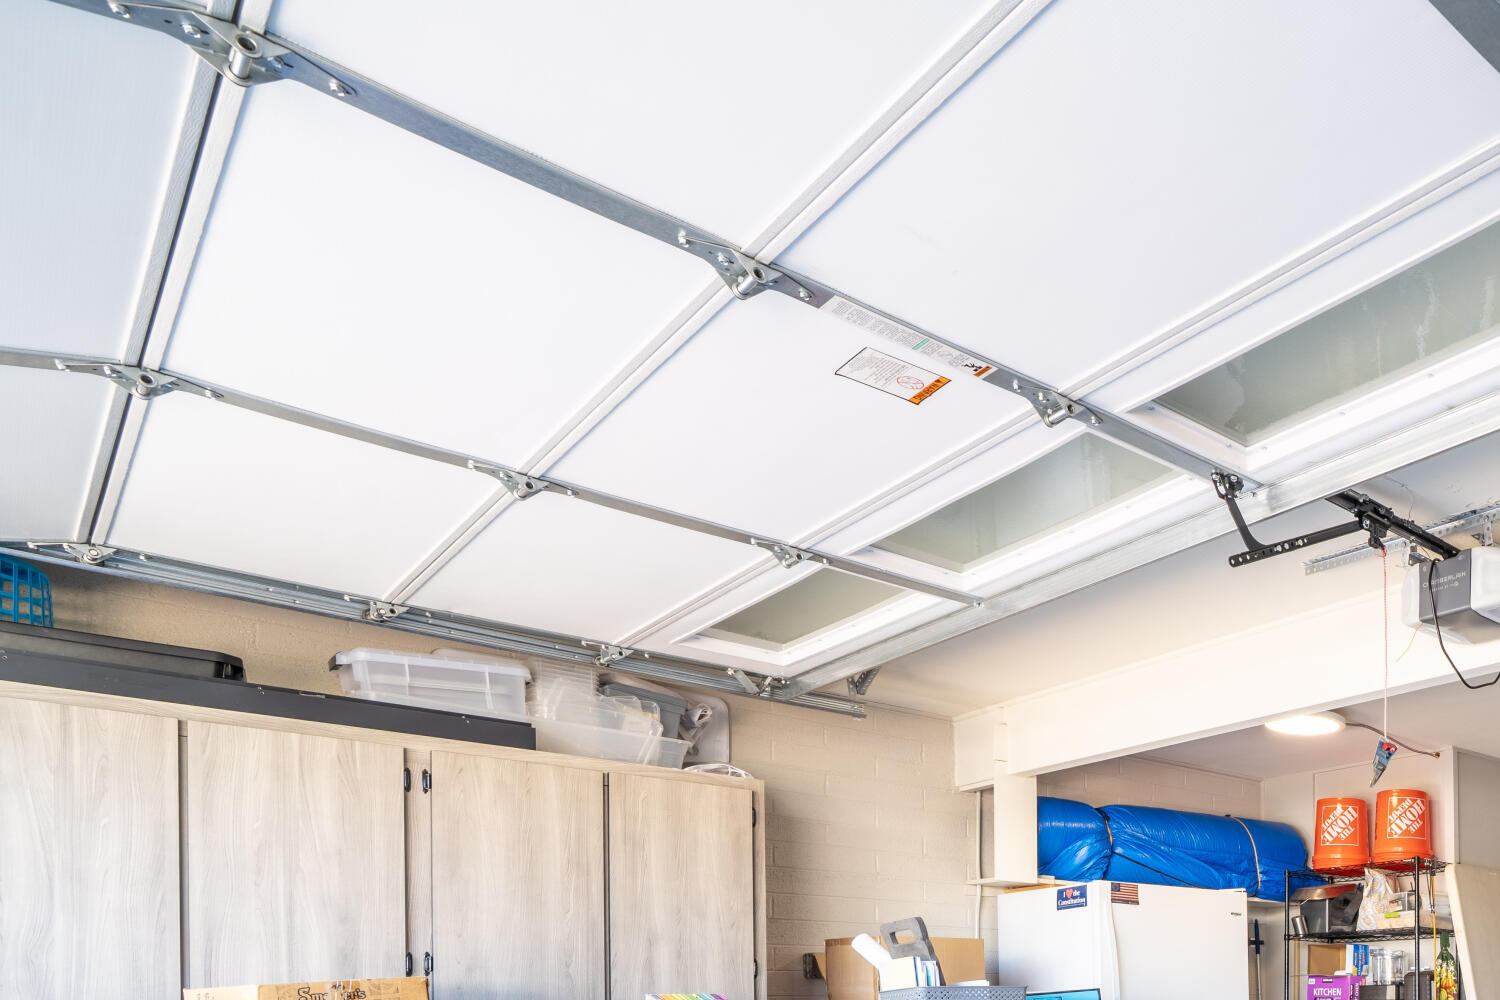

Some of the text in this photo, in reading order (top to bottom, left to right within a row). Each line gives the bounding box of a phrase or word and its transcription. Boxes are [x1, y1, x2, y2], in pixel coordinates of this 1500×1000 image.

[1322, 805, 1344, 831] DEPOT
[1387, 799, 1426, 838] HOME
[1389, 797, 1413, 823] DEPOT
[1321, 805, 1359, 845] HOME
[1338, 826, 1355, 841] THE
[1407, 818, 1424, 834] THE
[1313, 987, 1342, 996] KITCHEN
